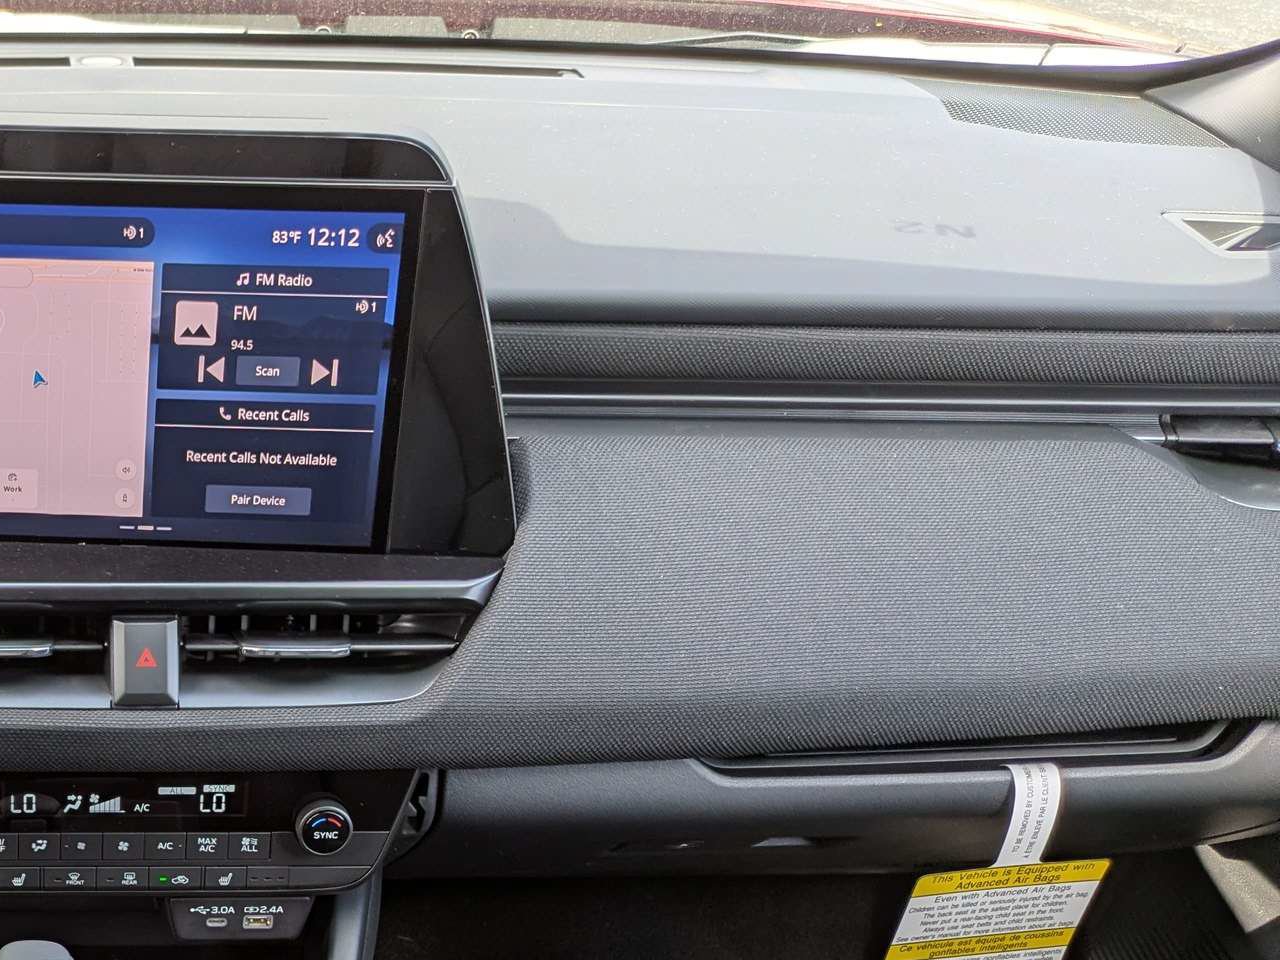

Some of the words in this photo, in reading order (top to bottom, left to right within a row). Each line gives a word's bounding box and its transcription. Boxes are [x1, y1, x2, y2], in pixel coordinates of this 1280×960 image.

[272, 230, 302, 244] 83°F
[307, 228, 360, 247] 12:12
[255, 273, 275, 286] FM
[277, 274, 313, 287] Radio
[233, 305, 257, 321] FM
[230, 339, 253, 351] 94.5
[255, 365, 280, 377] Scan
[237, 407, 279, 421] Recent
[281, 409, 310, 422] Calls
[186, 450, 227, 463] Recent
[229, 451, 257, 464] Calls
[259, 452, 282, 465] Not
[283, 453, 338, 466] Available
[3, 485, 22, 494] Work
[231, 494, 251, 505] Pair
[252, 495, 286, 506] Device
[133, 803, 151, 812] A/C
[197, 837, 217, 845] MAX
[313, 831, 339, 840] SYNC
[157, 841, 174, 850] A/C
[199, 845, 216, 853] A/C
[240, 845, 258, 853] ALL
[932, 875, 953, 883] This
[958, 870, 998, 879] Vehicle
[1015, 863, 1068, 876] Equipped
[955, 877, 1009, 889] Advanced
[1032, 873, 1061, 883] Bags
[935, 894, 957, 902] Even
[983, 888, 1028, 897] Advanced
[1047, 884, 1071, 893] Bags
[210, 905, 236, 915] 3.0A
[259, 905, 284, 914] 2.4A
[1024, 930, 1064, 939] coussins
[929, 946, 975, 957] gonflables
[979, 941, 1028, 951] intelligents
